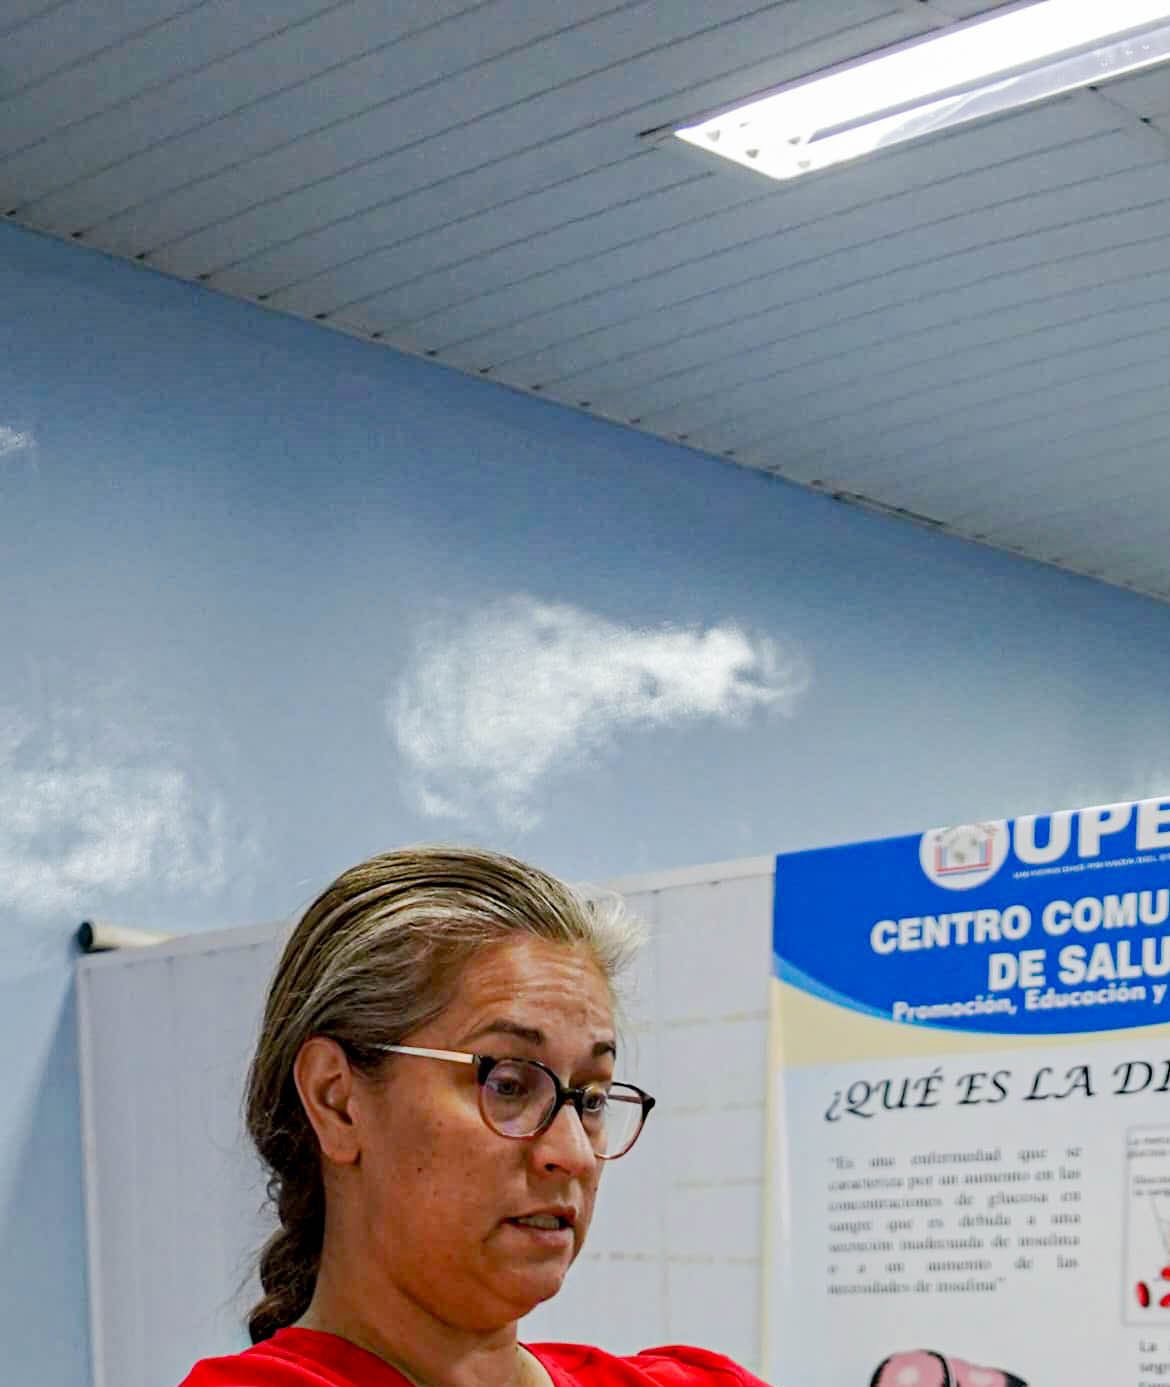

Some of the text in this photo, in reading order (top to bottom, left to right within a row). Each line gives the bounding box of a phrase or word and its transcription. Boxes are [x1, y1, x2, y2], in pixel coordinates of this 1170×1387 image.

[870, 904, 1027, 954] CENTRO
[988, 952, 1046, 992] DE
[892, 993, 1018, 1024] Promoción,
[1025, 979, 1147, 1013] Educación
[1152, 986, 1167, 1006] y
[823, 1067, 944, 1122] ¿QUÉ
[955, 1070, 1012, 1106] ES
[1025, 1066, 1096, 1101] LA
